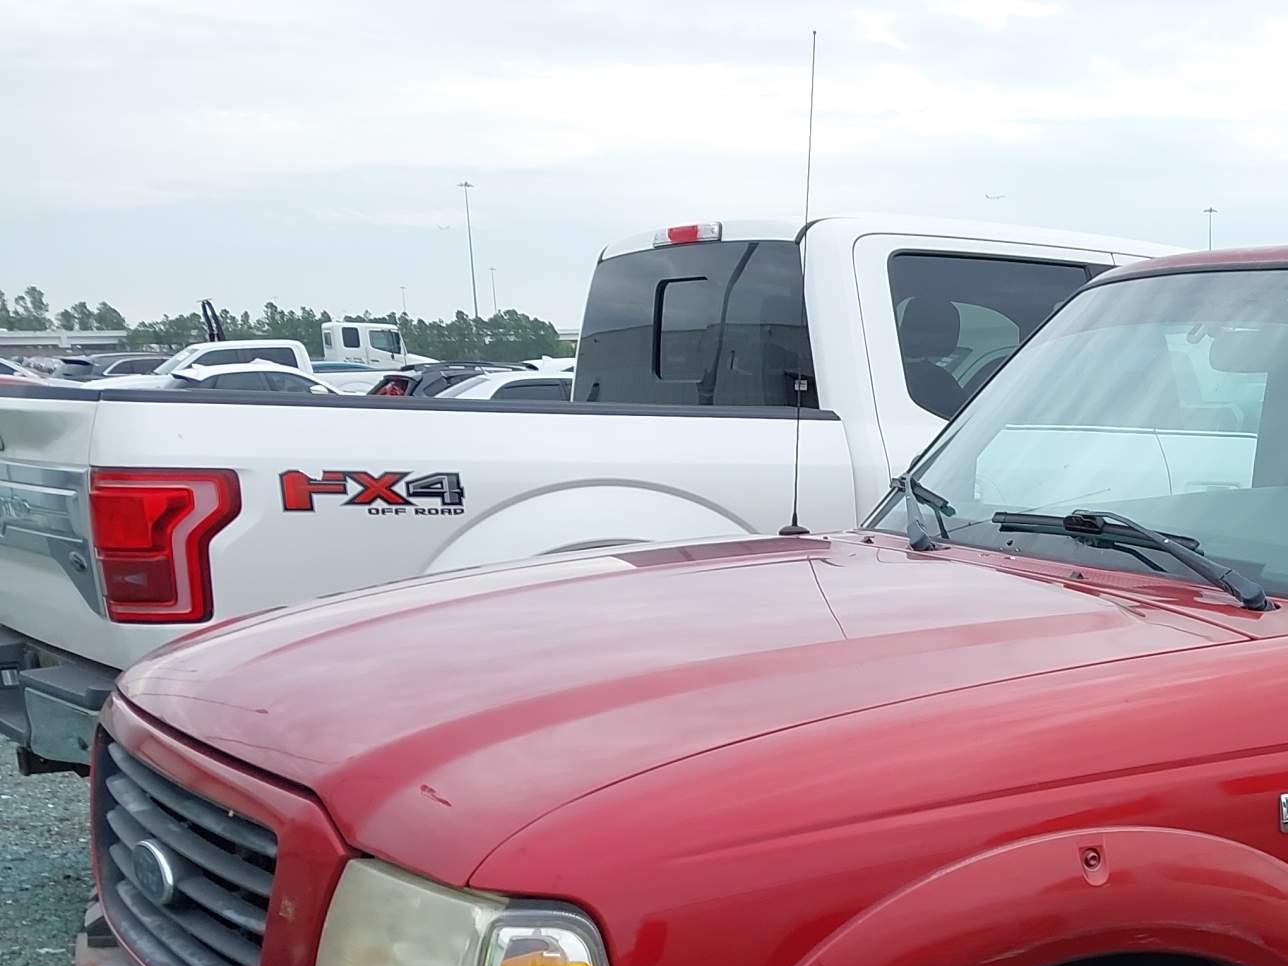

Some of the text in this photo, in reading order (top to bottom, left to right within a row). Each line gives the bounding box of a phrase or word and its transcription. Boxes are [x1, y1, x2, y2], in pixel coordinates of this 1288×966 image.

[279, 470, 465, 512] FX4
[368, 507, 465, 516] OFF ROAD
